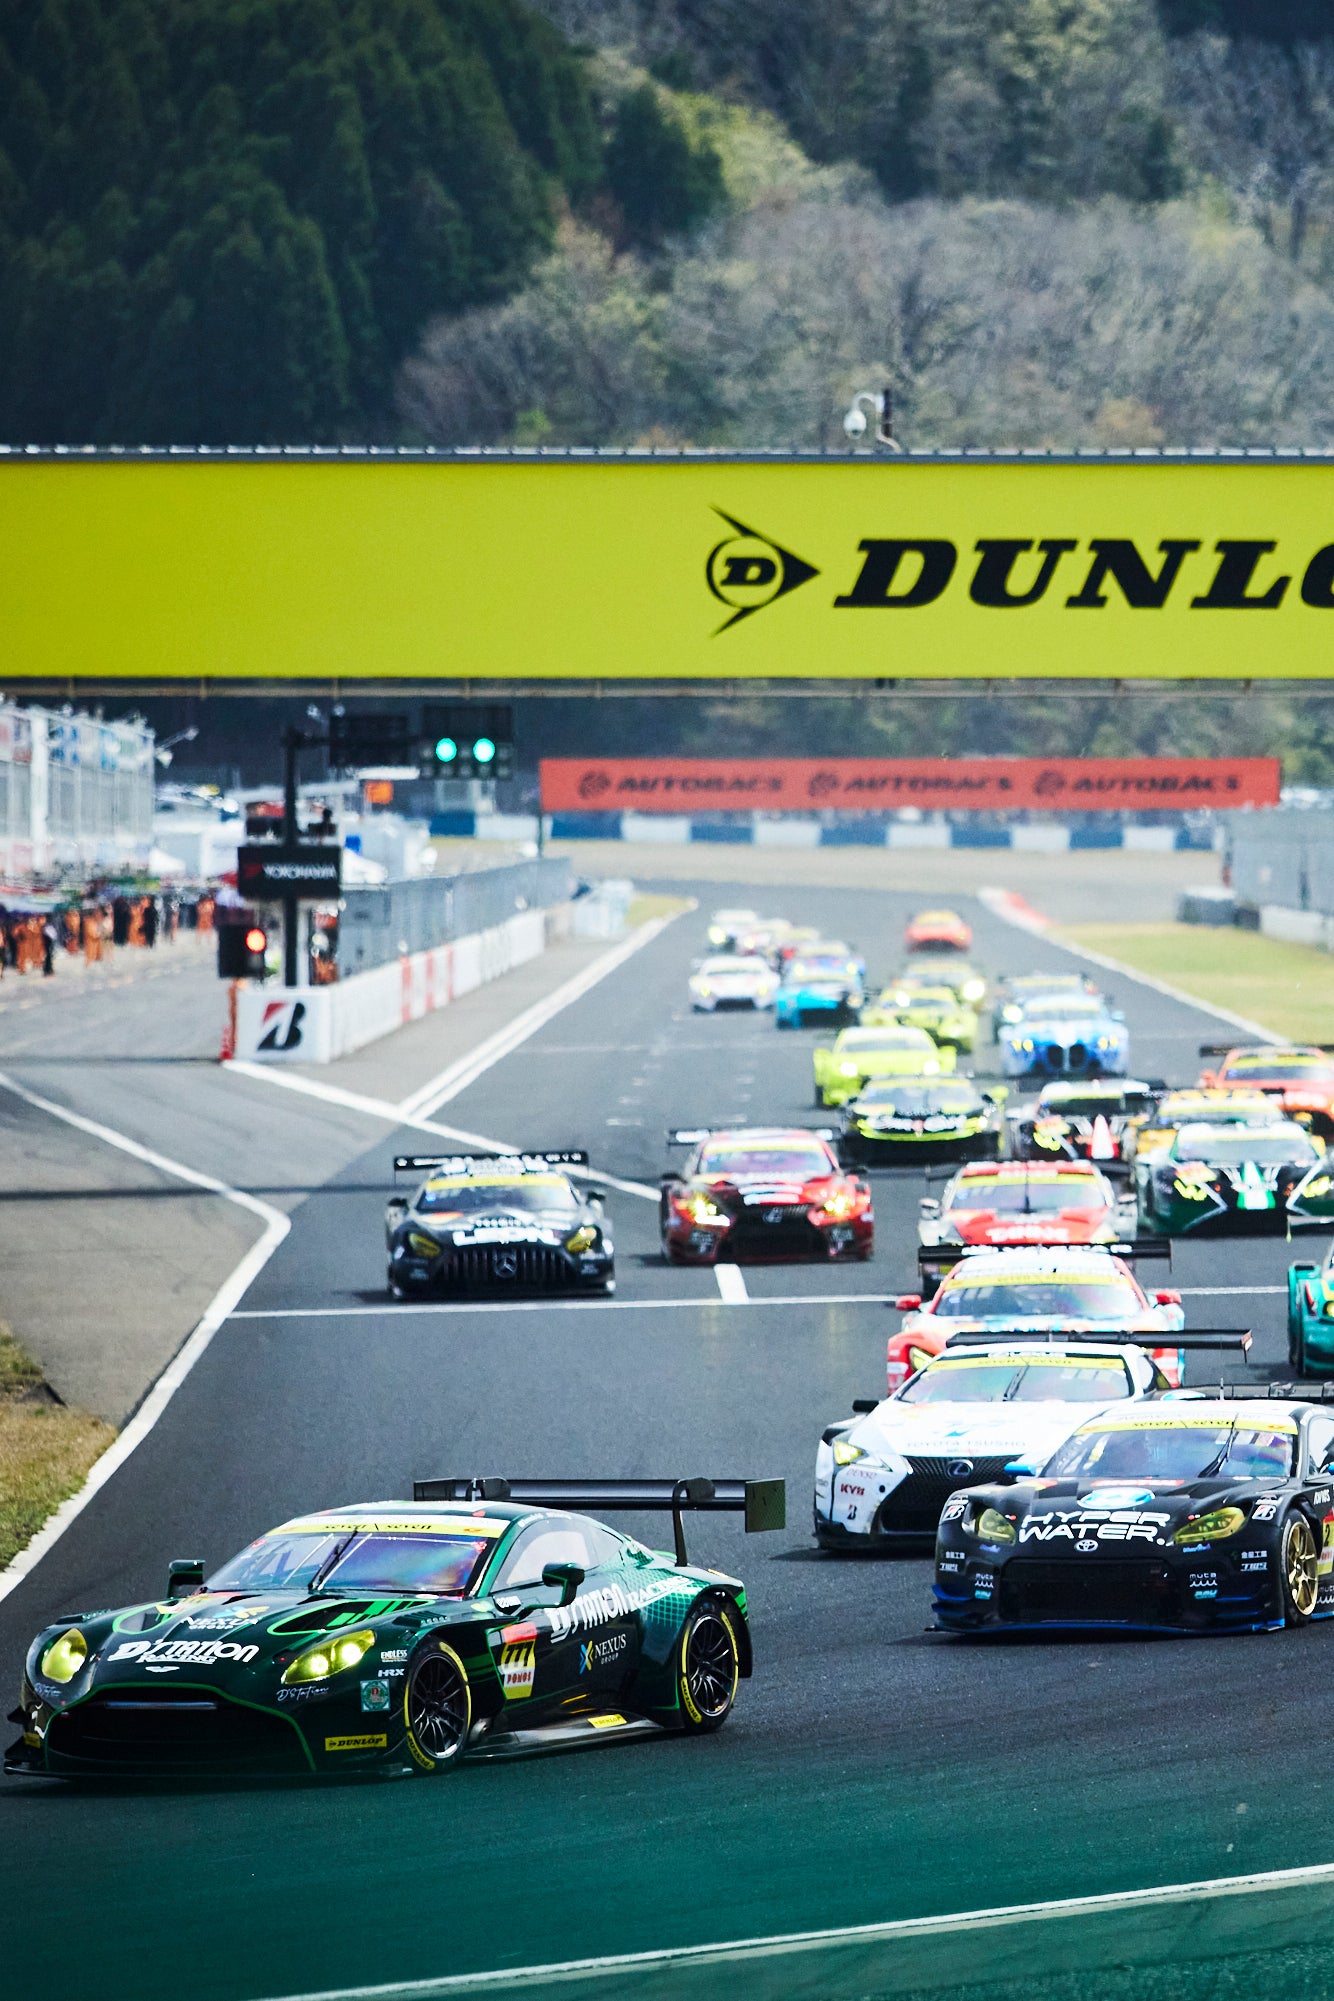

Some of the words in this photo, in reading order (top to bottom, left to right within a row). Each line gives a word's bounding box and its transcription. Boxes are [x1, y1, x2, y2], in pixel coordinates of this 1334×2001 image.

[616, 776, 784, 793] AUTOBACS
[844, 775, 1013, 792] AUTOBACS
[1072, 774, 1240, 792] AUTOBACS
[264, 864, 337, 879] YOKOHAMA
[841, 1484, 865, 1496] KYB
[1021, 1511, 1171, 1528] HYPER
[1019, 1524, 1166, 1546] WATER.
[381, 1649, 408, 1659] ENDLESS
[594, 1633, 627, 1659] NEXUS
[136, 1651, 218, 1664] RACING
[505, 1641, 534, 1668] 777
[600, 1653, 619, 1665] GROUP
[506, 1671, 532, 1685] PONOS
[337, 1738, 384, 1747] DUNLOP
